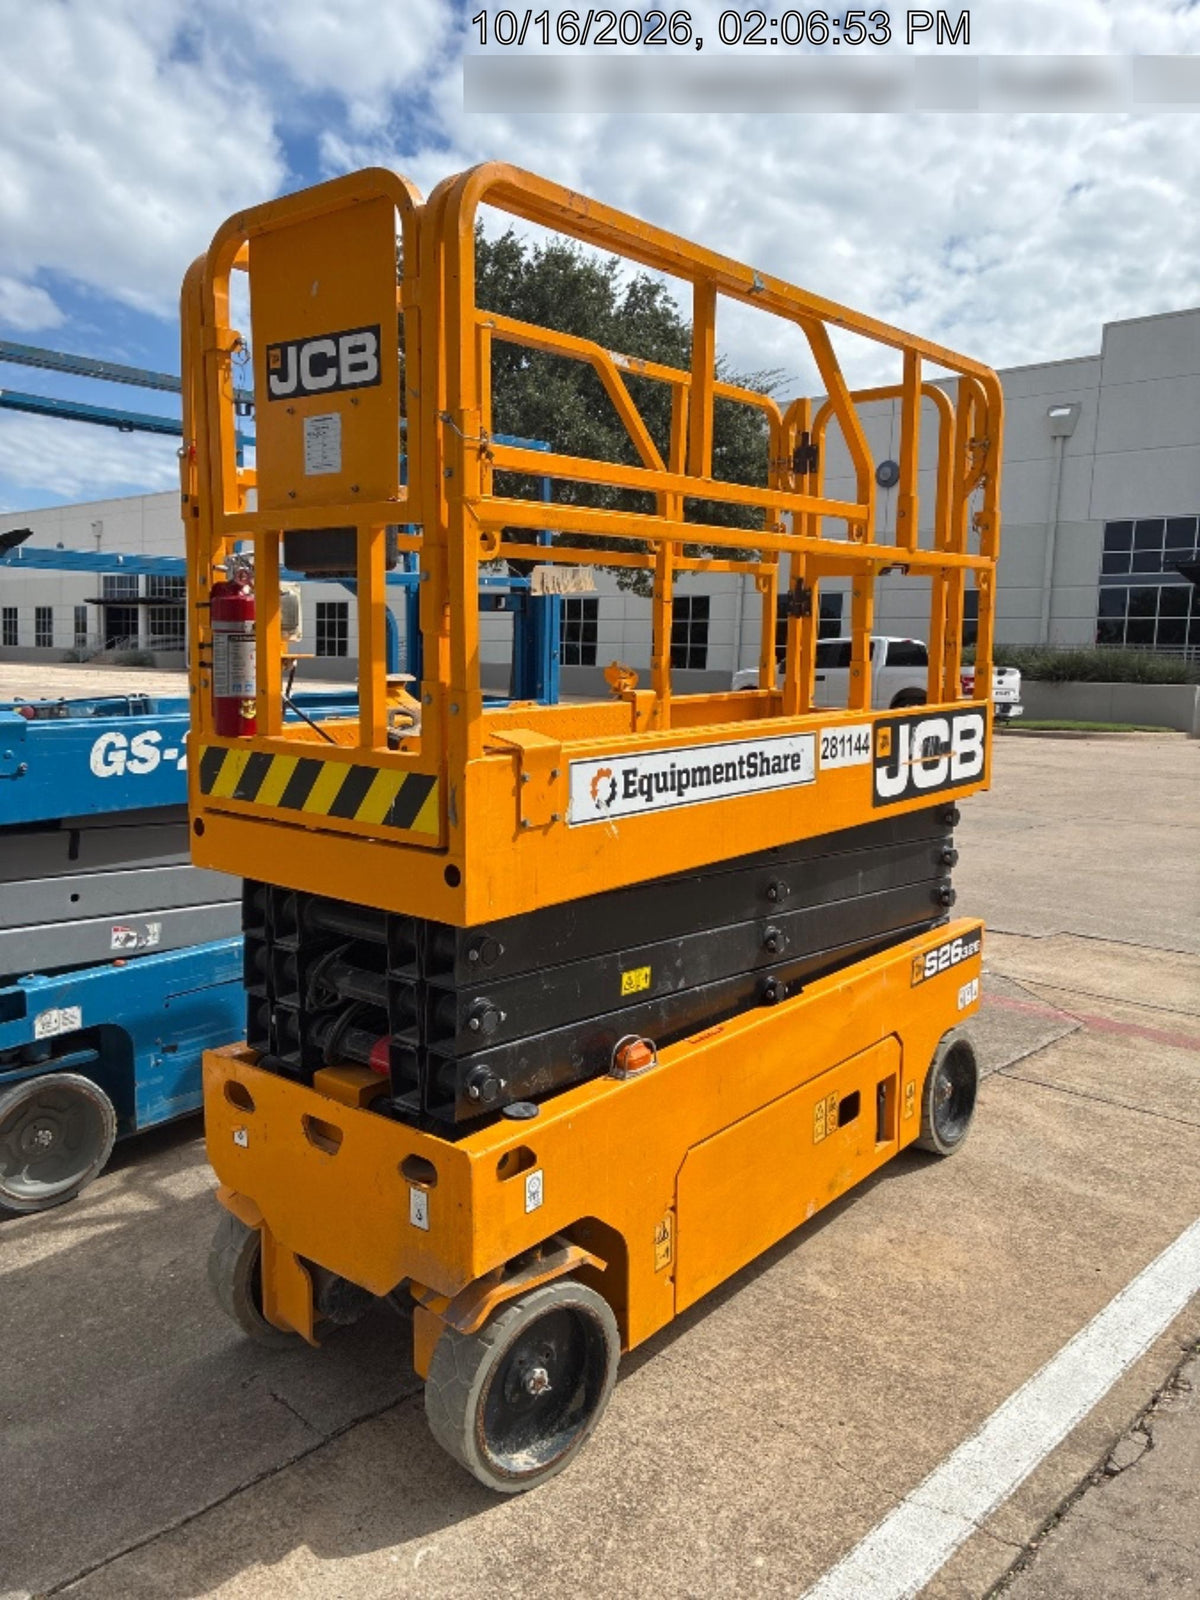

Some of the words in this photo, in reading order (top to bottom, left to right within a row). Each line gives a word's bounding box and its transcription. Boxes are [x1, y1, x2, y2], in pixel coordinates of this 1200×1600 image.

[269, 332, 378, 396] JCB
[821, 732, 870, 760] 281144
[876, 714, 984, 797] JCB
[622, 751, 801, 803] EquipmentShare
